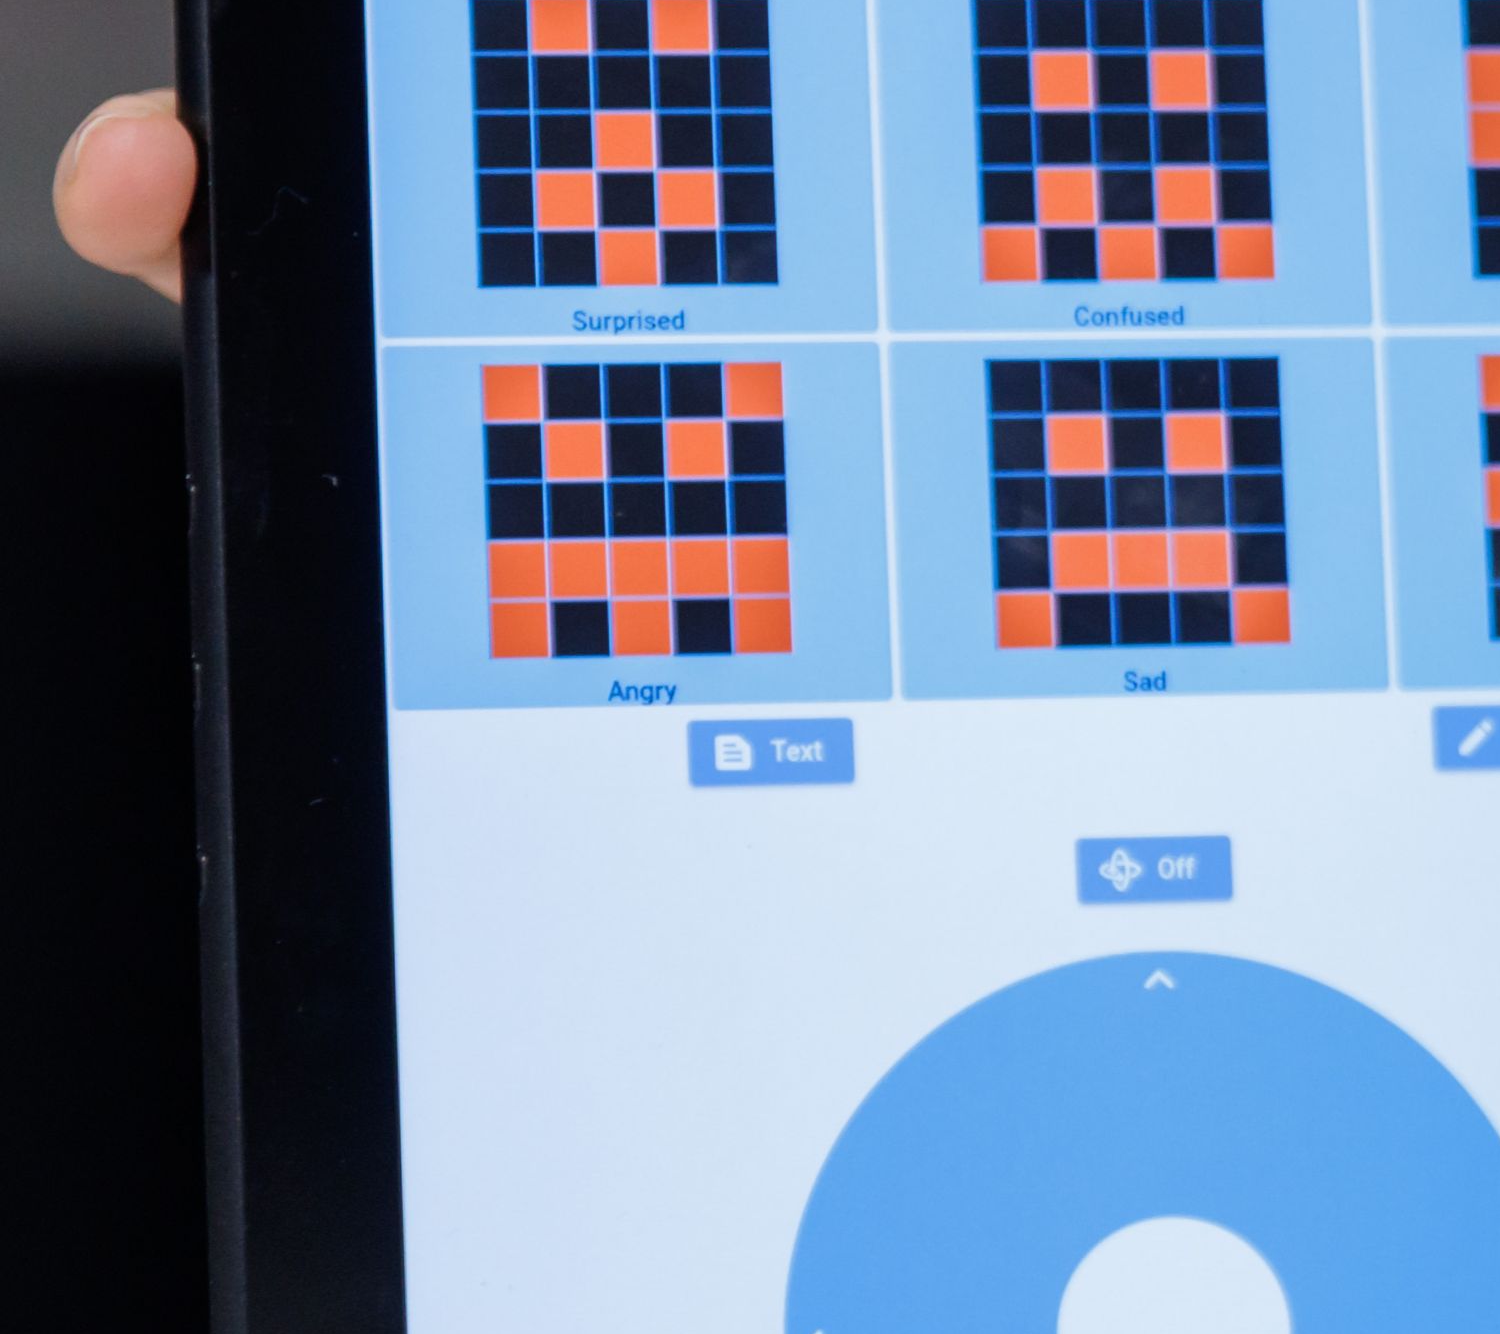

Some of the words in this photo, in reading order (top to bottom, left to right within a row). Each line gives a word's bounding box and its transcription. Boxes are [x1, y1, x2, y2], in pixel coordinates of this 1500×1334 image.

[572, 309, 686, 334] Surprised
[1073, 304, 1186, 328] Confused
[608, 680, 677, 705] Angry
[1122, 669, 1168, 693] Sad
[770, 738, 824, 762] Text
[1158, 855, 1197, 880] Off
